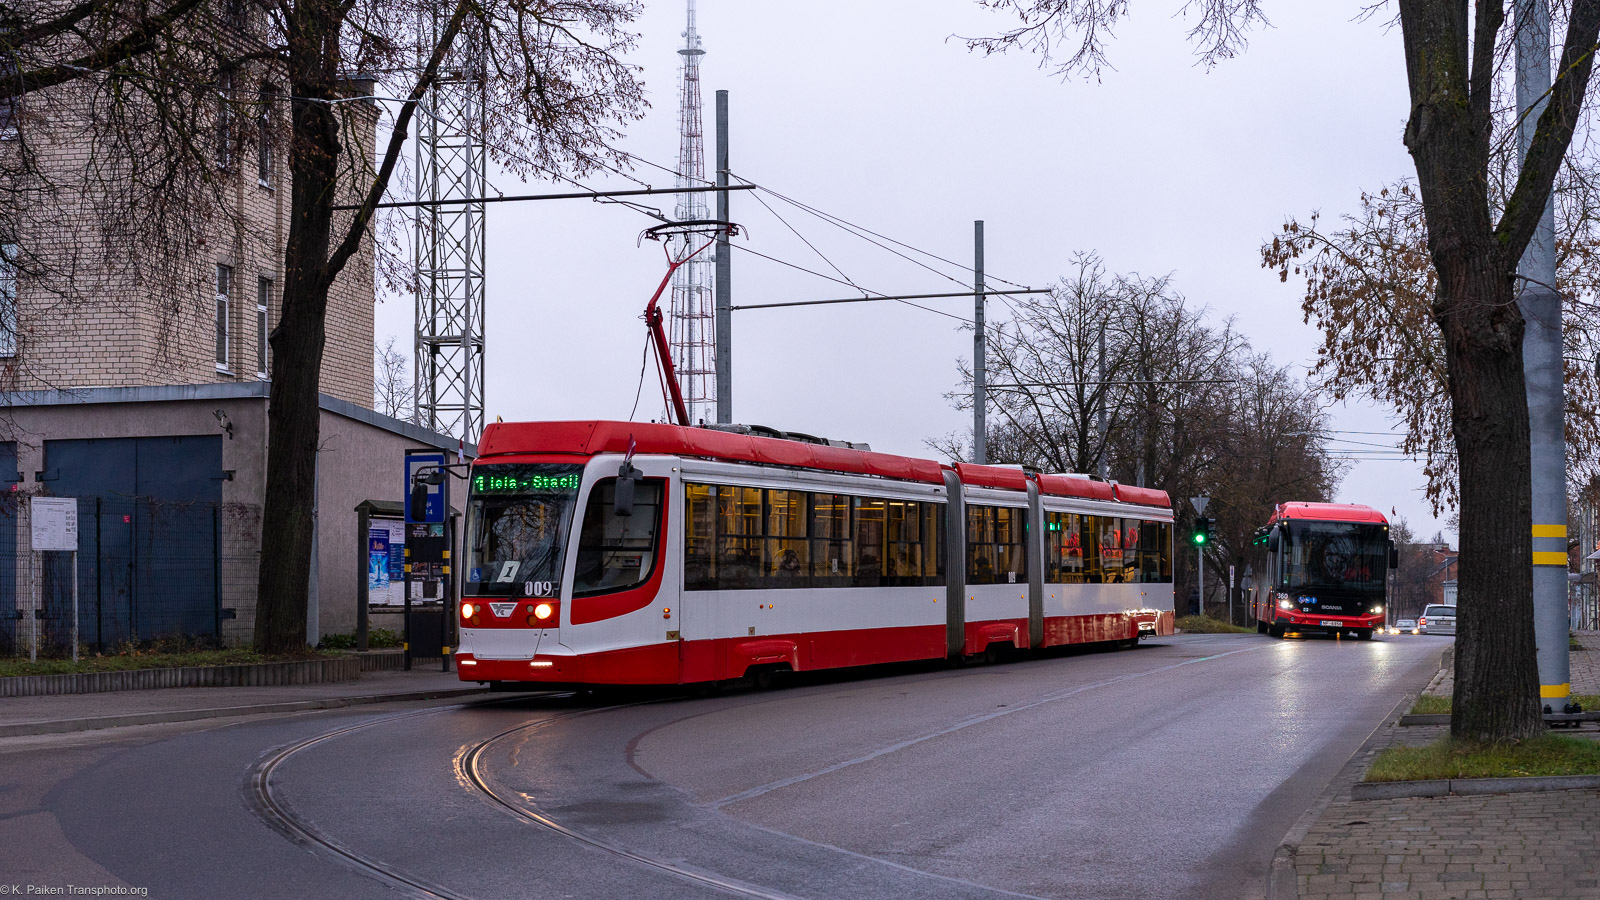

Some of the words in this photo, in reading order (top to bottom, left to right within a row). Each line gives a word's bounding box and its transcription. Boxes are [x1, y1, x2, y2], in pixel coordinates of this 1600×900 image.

[476, 476, 484, 490] 1
[504, 566, 513, 577] 1
[524, 582, 552, 596] 009
